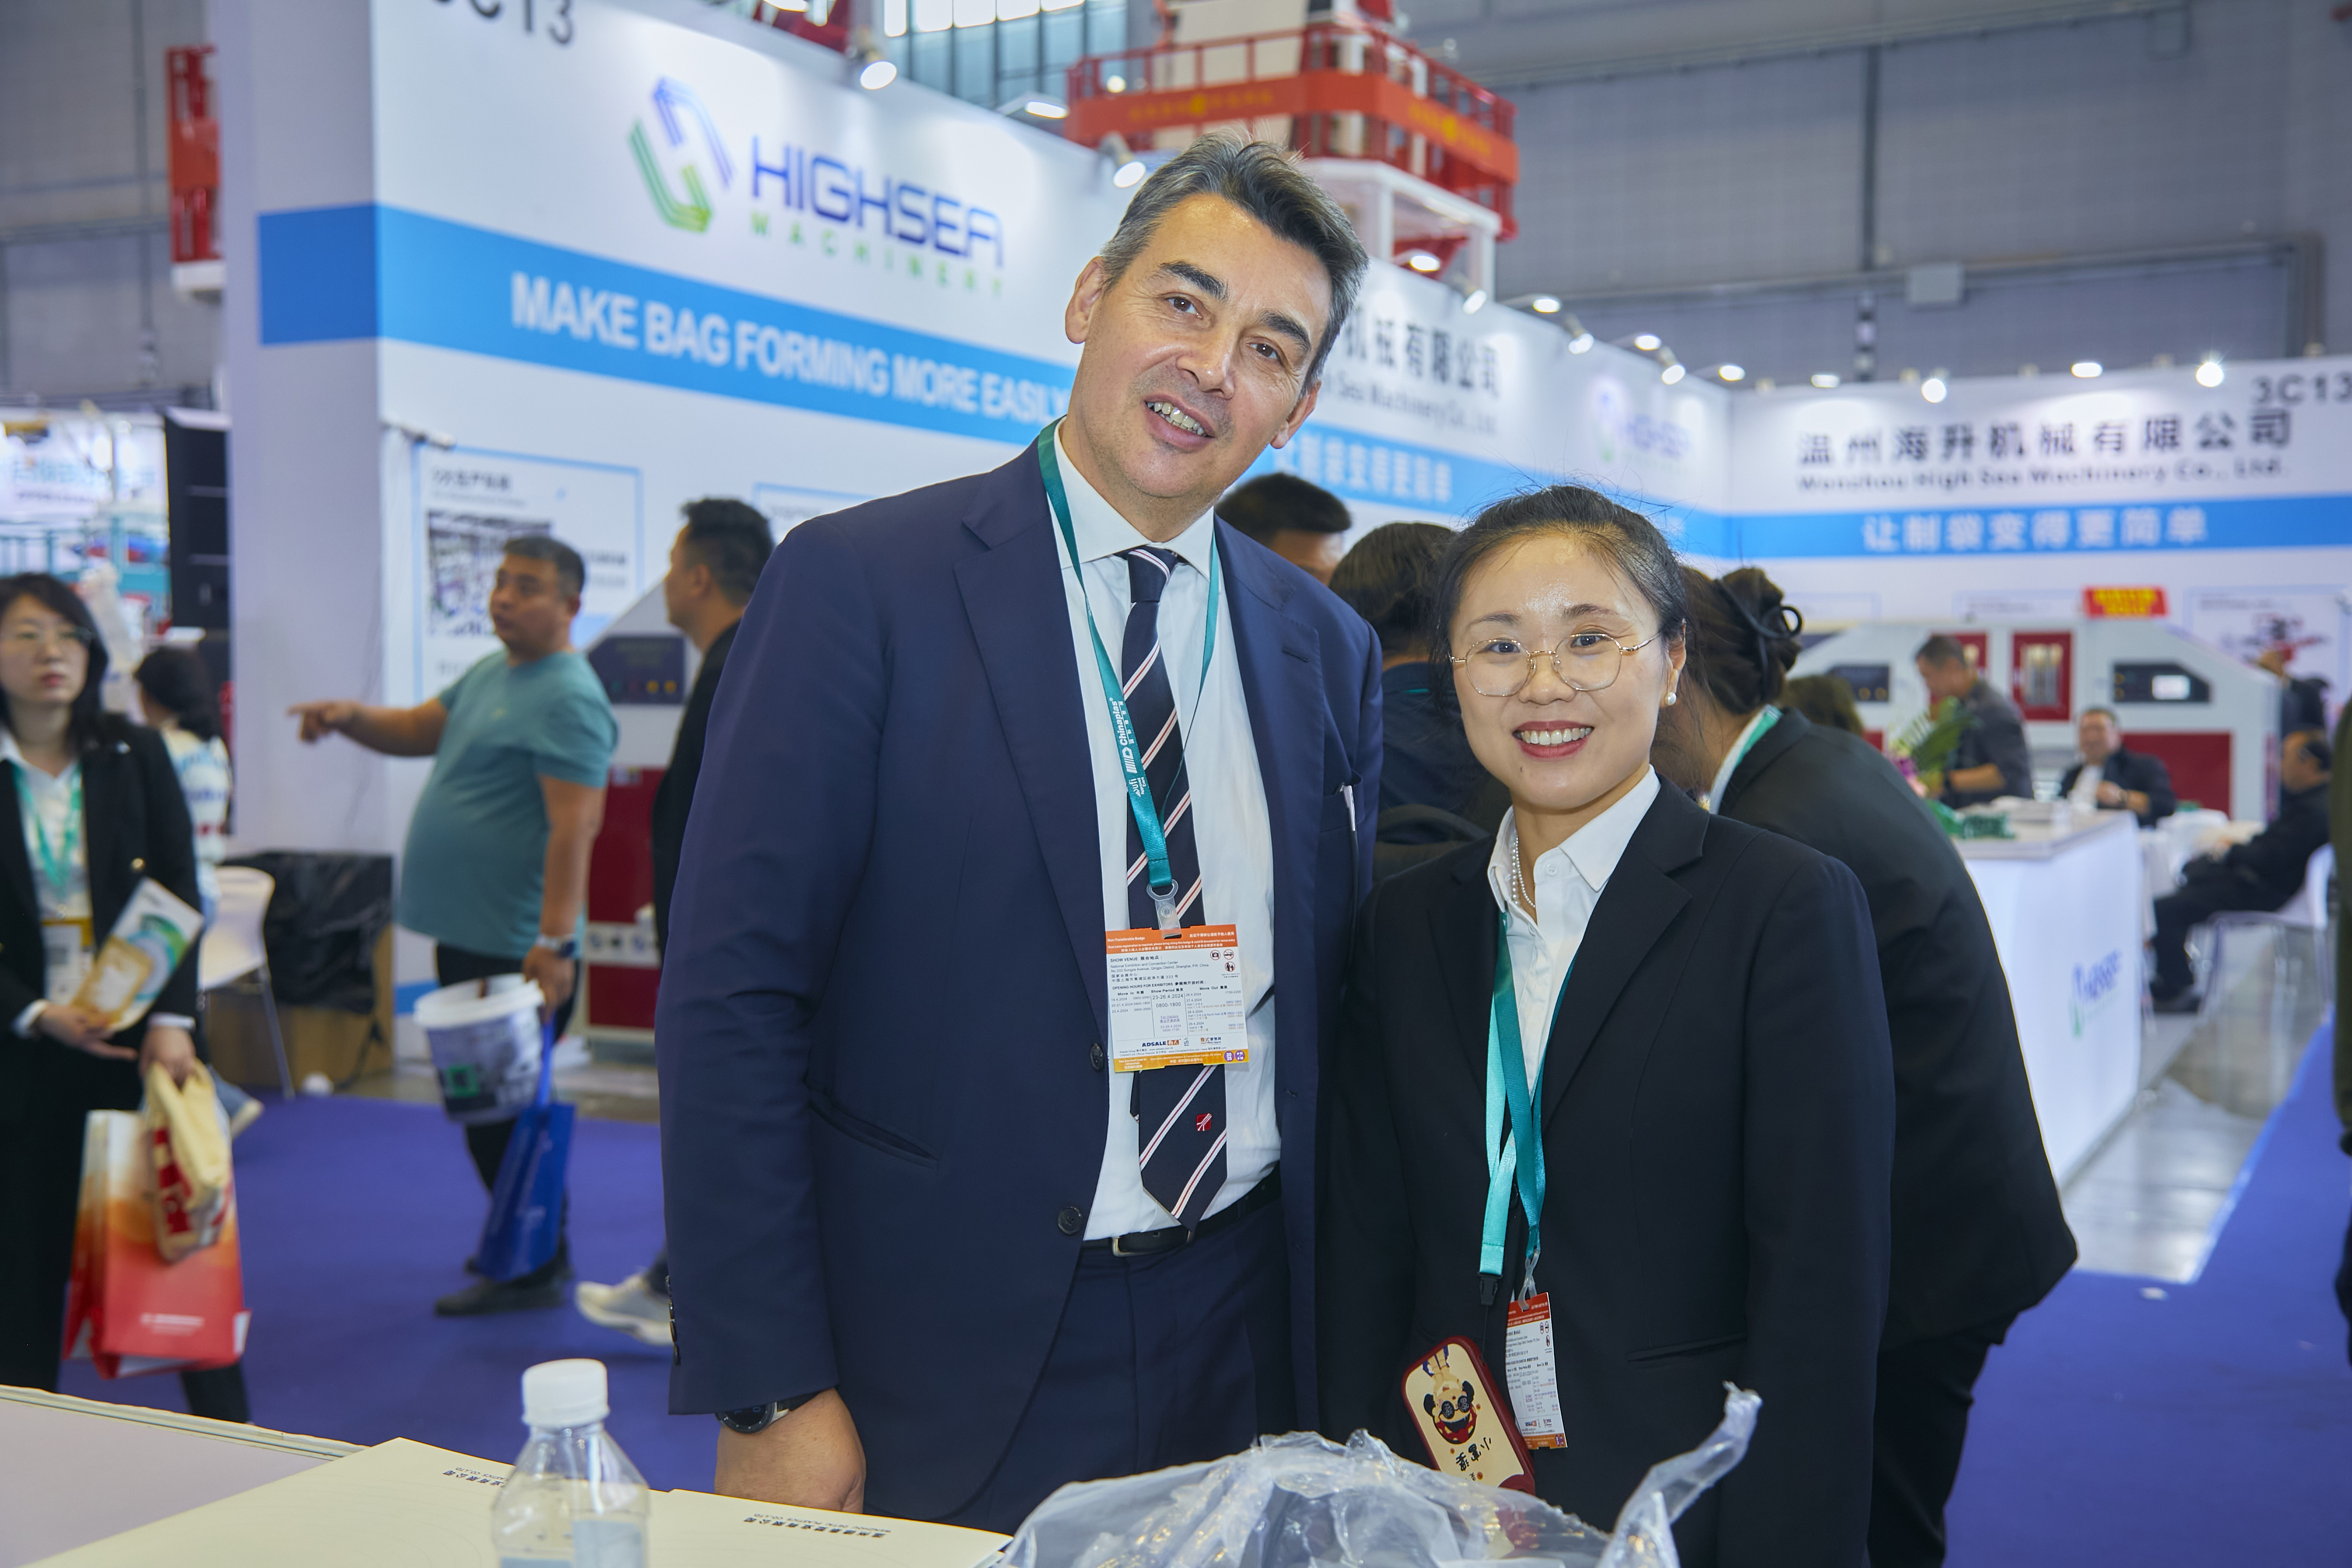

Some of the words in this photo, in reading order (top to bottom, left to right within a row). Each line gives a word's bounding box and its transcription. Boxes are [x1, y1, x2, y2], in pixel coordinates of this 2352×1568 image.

[751, 136, 1003, 267] HIGHSEA
[511, 271, 639, 349] MAKE
[644, 300, 732, 367] BAG
[735, 320, 889, 398] FORMING
[893, 353, 978, 413] MORE
[1129, 778, 1138, 790] ufi
[442, 1470, 505, 1487] 业有限公司
